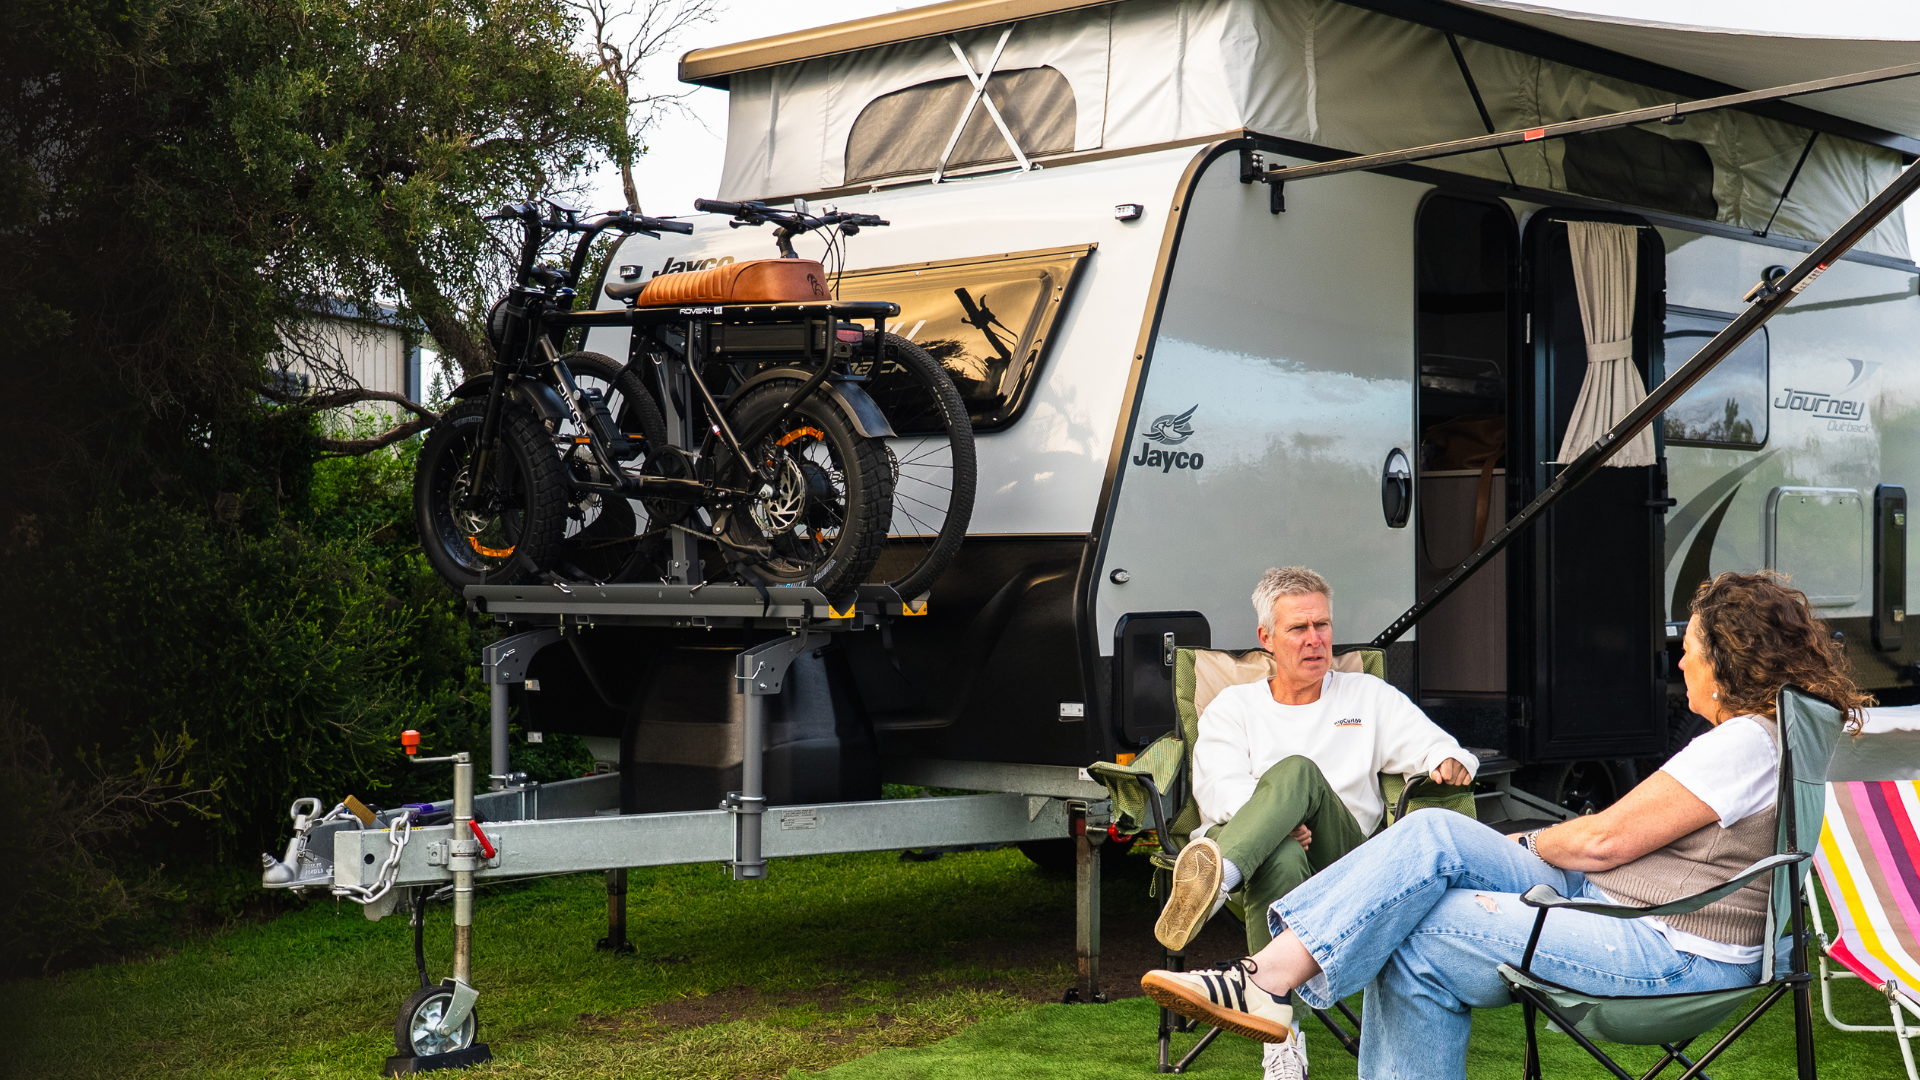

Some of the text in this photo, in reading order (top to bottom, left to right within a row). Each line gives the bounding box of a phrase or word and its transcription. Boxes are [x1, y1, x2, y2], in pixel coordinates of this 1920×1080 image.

[1773, 388, 1865, 421] Journey
[1827, 420, 1870, 433] Outback
[1133, 442, 1204, 473] Jayco
